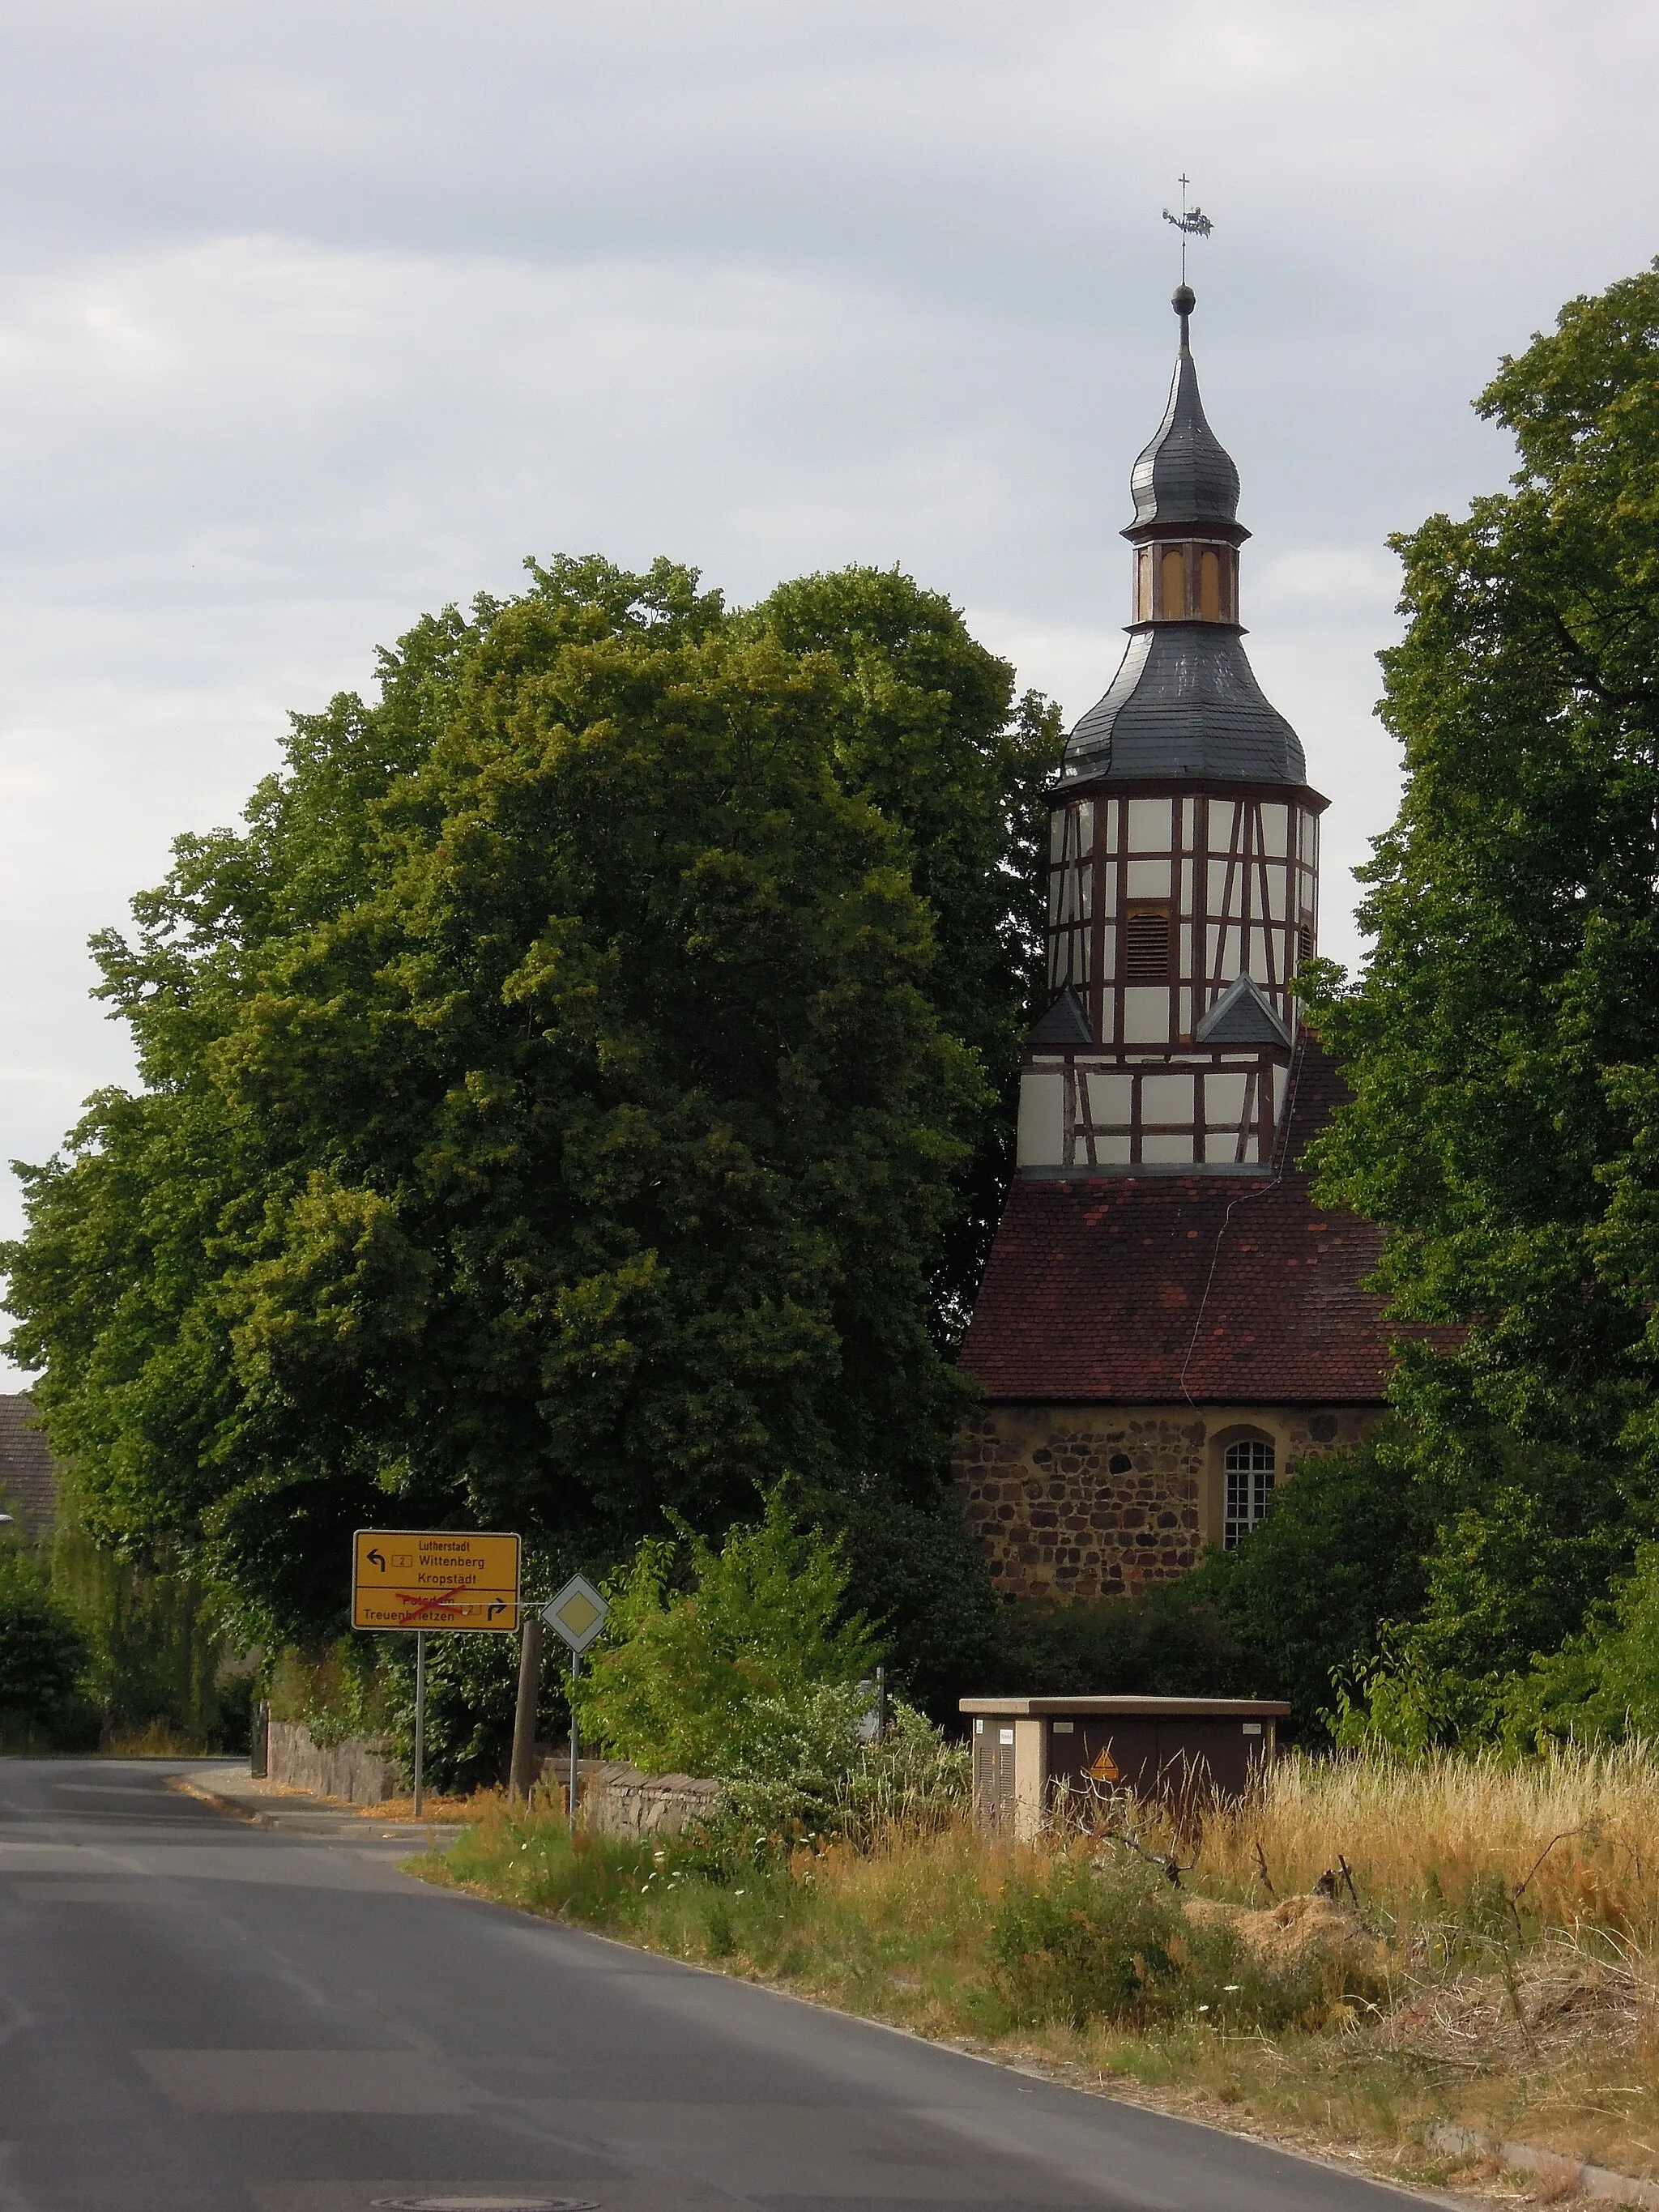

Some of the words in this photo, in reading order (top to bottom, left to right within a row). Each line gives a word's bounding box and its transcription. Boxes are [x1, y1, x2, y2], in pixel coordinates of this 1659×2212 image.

[418, 1541, 469, 1551] Lutherstadt
[399, 1557, 405, 1565] 2
[419, 1555, 484, 1569] Wittenberg
[418, 1573, 476, 1585] Kropstädt
[364, 1609, 454, 1622] Treuenbietzen
